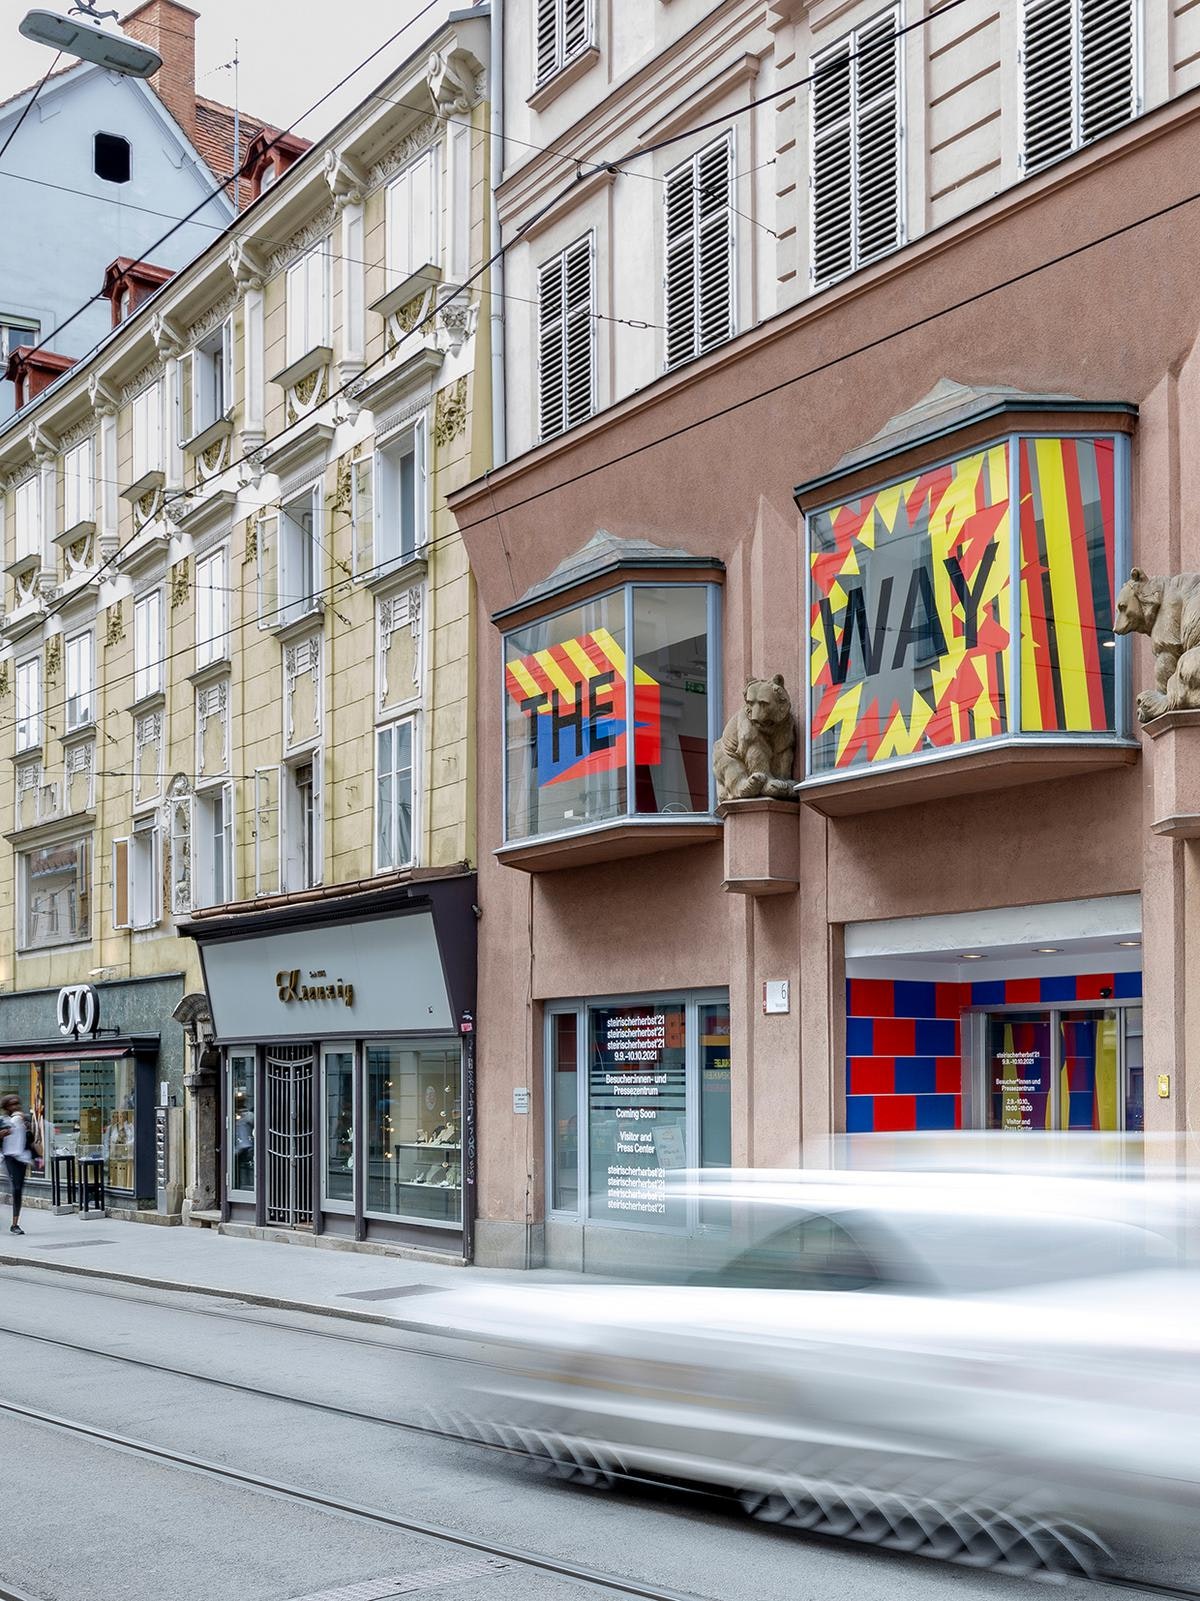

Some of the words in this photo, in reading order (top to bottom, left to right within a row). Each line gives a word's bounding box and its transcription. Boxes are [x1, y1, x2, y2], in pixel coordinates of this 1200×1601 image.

[819, 541, 998, 686] WAY
[521, 671, 616, 769] THE
[781, 983, 787, 999] 6
[655, 1073, 667, 1083] und
[614, 1085, 658, 1096] Pressezentrum
[616, 1108, 639, 1120] Coming
[640, 1109, 656, 1119] Soon
[620, 1131, 639, 1141] Visitor
[640, 1132, 652, 1142] and
[617, 1142, 633, 1153] Press
[634, 1143, 655, 1154] Center
